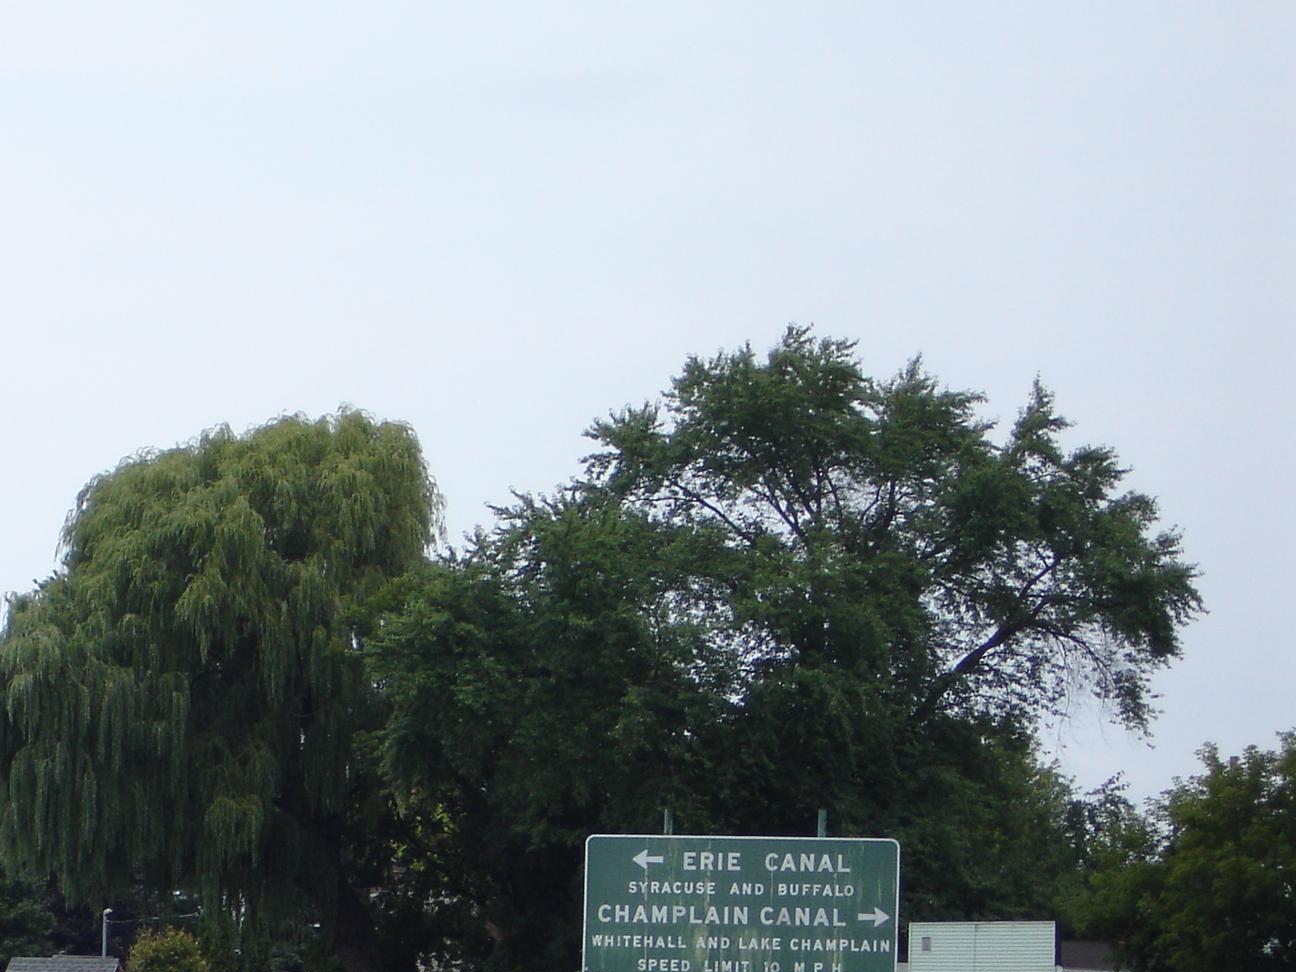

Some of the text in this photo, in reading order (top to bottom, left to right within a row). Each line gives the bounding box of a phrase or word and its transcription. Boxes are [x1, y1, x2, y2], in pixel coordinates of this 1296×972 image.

[684, 852, 851, 873] ERIE CANAL
[628, 882, 854, 897] SYRACUSE AND BUFFALO
[598, 905, 846, 927] CHAMPLAIN CANAL
[592, 935, 890, 952] WHITEHALL AND LAKE CHAMPLAIN
[638, 960, 690, 972] SPEED
[704, 961, 749, 972] LIMIT
